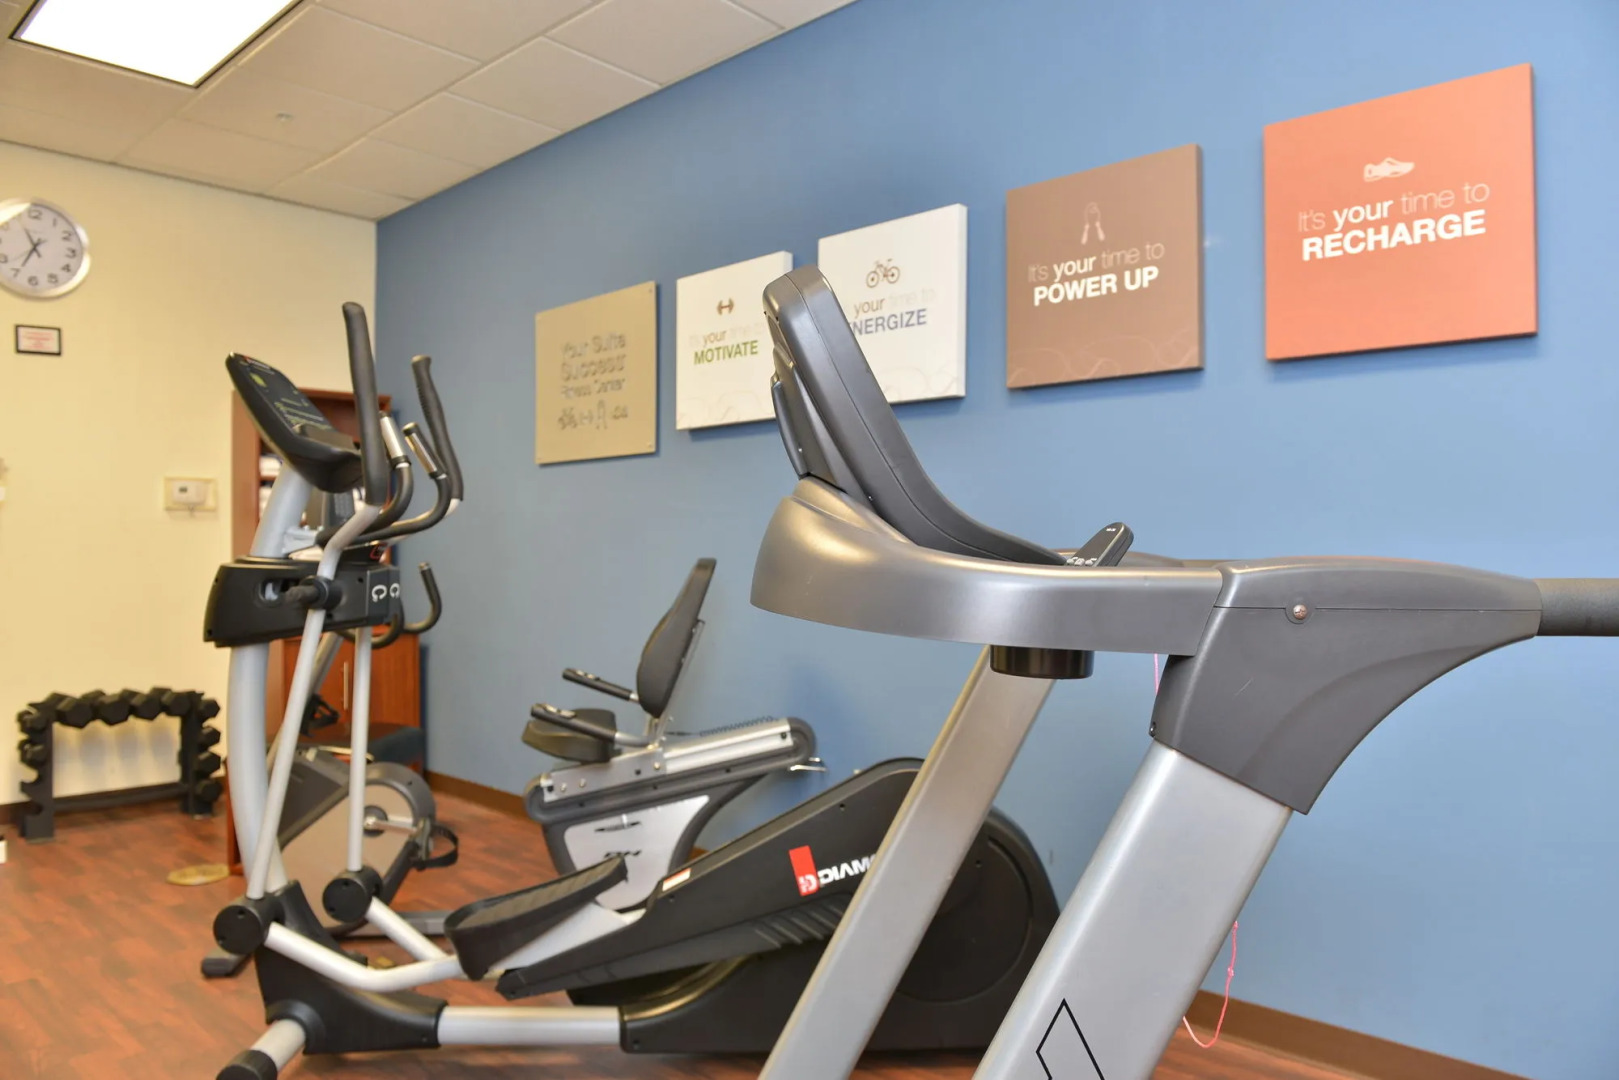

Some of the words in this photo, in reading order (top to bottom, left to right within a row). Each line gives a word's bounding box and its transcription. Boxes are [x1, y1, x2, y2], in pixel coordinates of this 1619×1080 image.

[1333, 200, 1394, 231] your
[1400, 189, 1455, 215] time
[1463, 182, 1490, 204] to
[1301, 209, 1486, 261] RECHARGE
[1053, 256, 1097, 282] your
[1101, 247, 1140, 269] time
[1145, 241, 1165, 261] to
[1033, 273, 1118, 307] POWER
[1124, 266, 1159, 290] UP
[849, 308, 927, 336] NERGIZE
[853, 298, 886, 319] your
[693, 340, 759, 365] MOTIVATE
